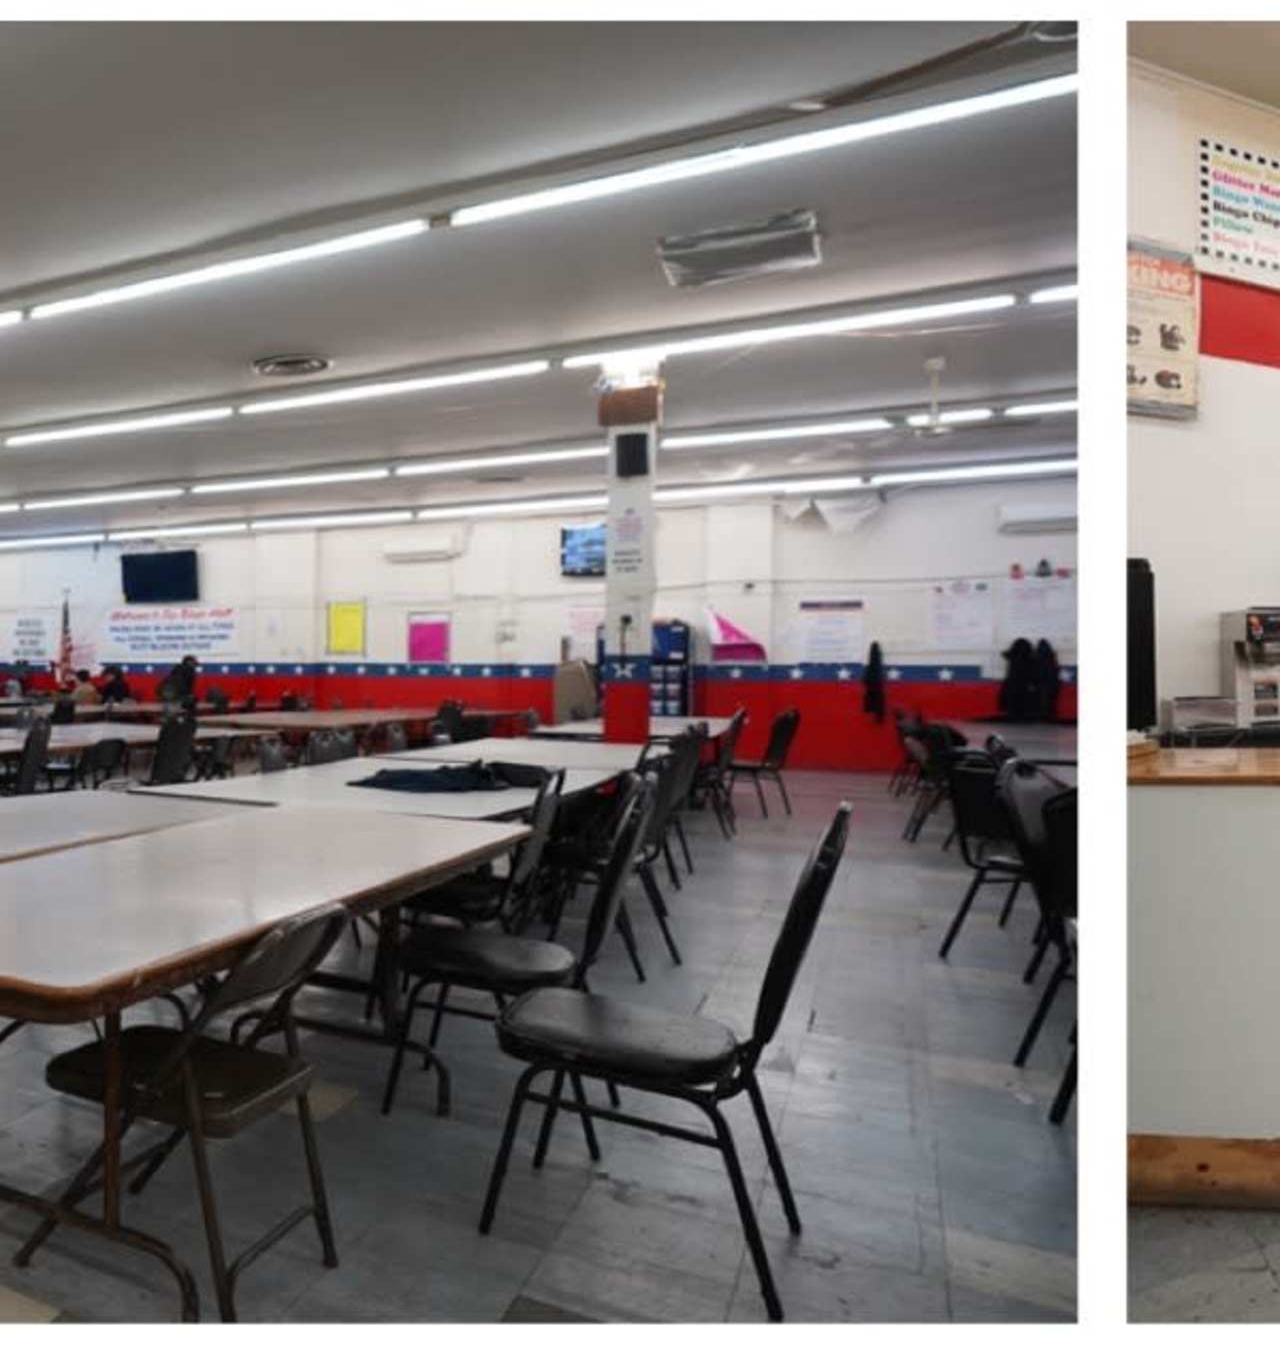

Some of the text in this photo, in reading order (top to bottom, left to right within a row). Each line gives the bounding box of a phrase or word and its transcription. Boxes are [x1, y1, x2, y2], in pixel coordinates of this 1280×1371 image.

[1212, 170, 1255, 190] Glitter
[1212, 185, 1250, 204] Bingo
[1213, 200, 1250, 219] Bingo
